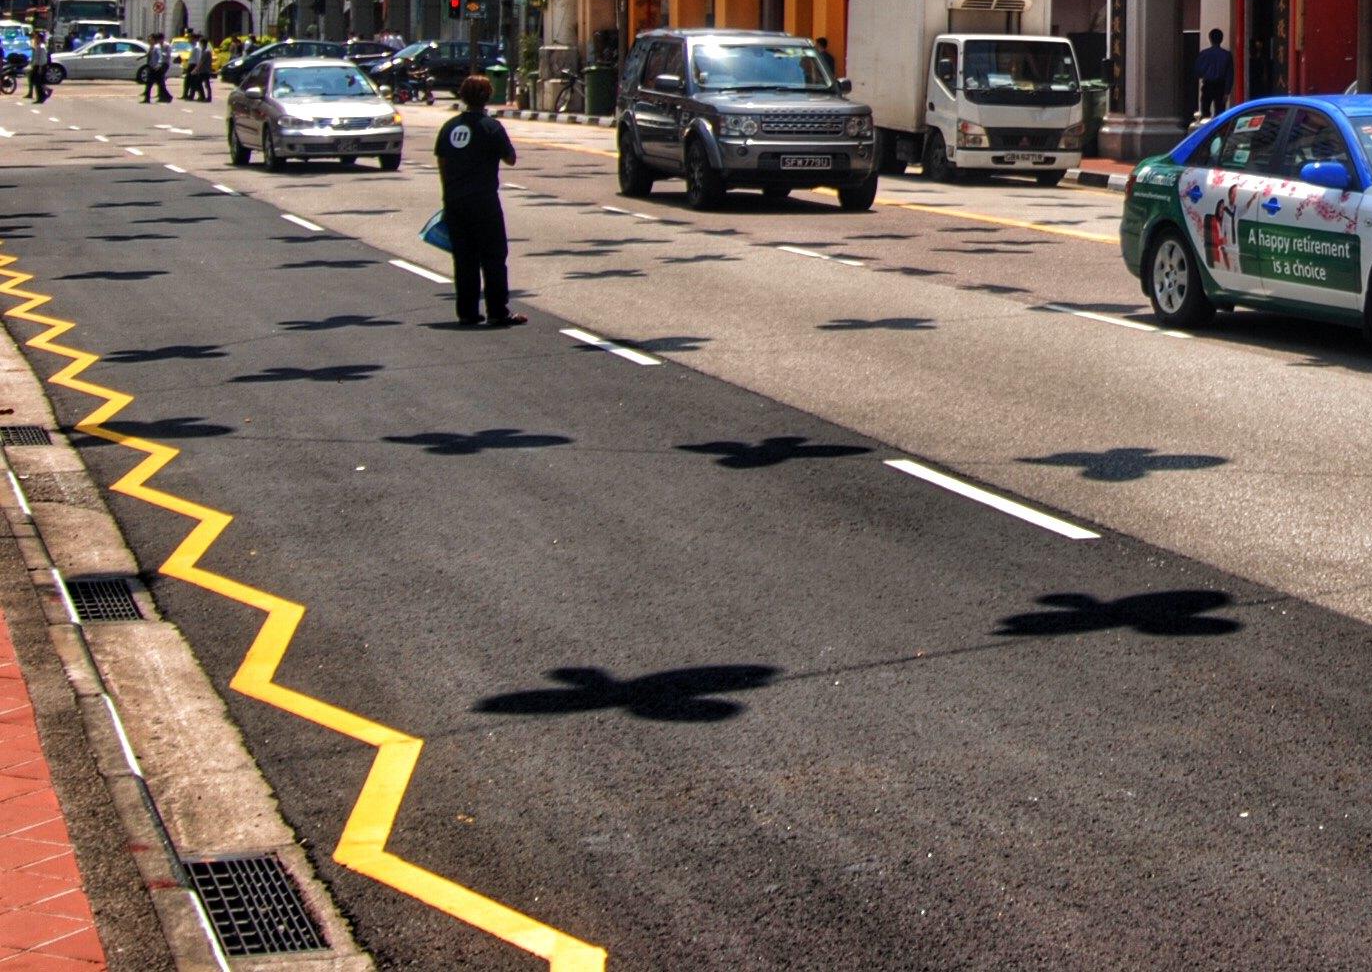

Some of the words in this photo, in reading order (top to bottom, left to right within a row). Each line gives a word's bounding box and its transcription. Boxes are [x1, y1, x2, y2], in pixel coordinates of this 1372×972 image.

[1248, 228, 1257, 244] A
[1258, 231, 1290, 254] happy
[1292, 234, 1350, 259] retirement
[1272, 257, 1282, 274] is
[1284, 263, 1291, 275] a
[1292, 258, 1328, 282] choice
